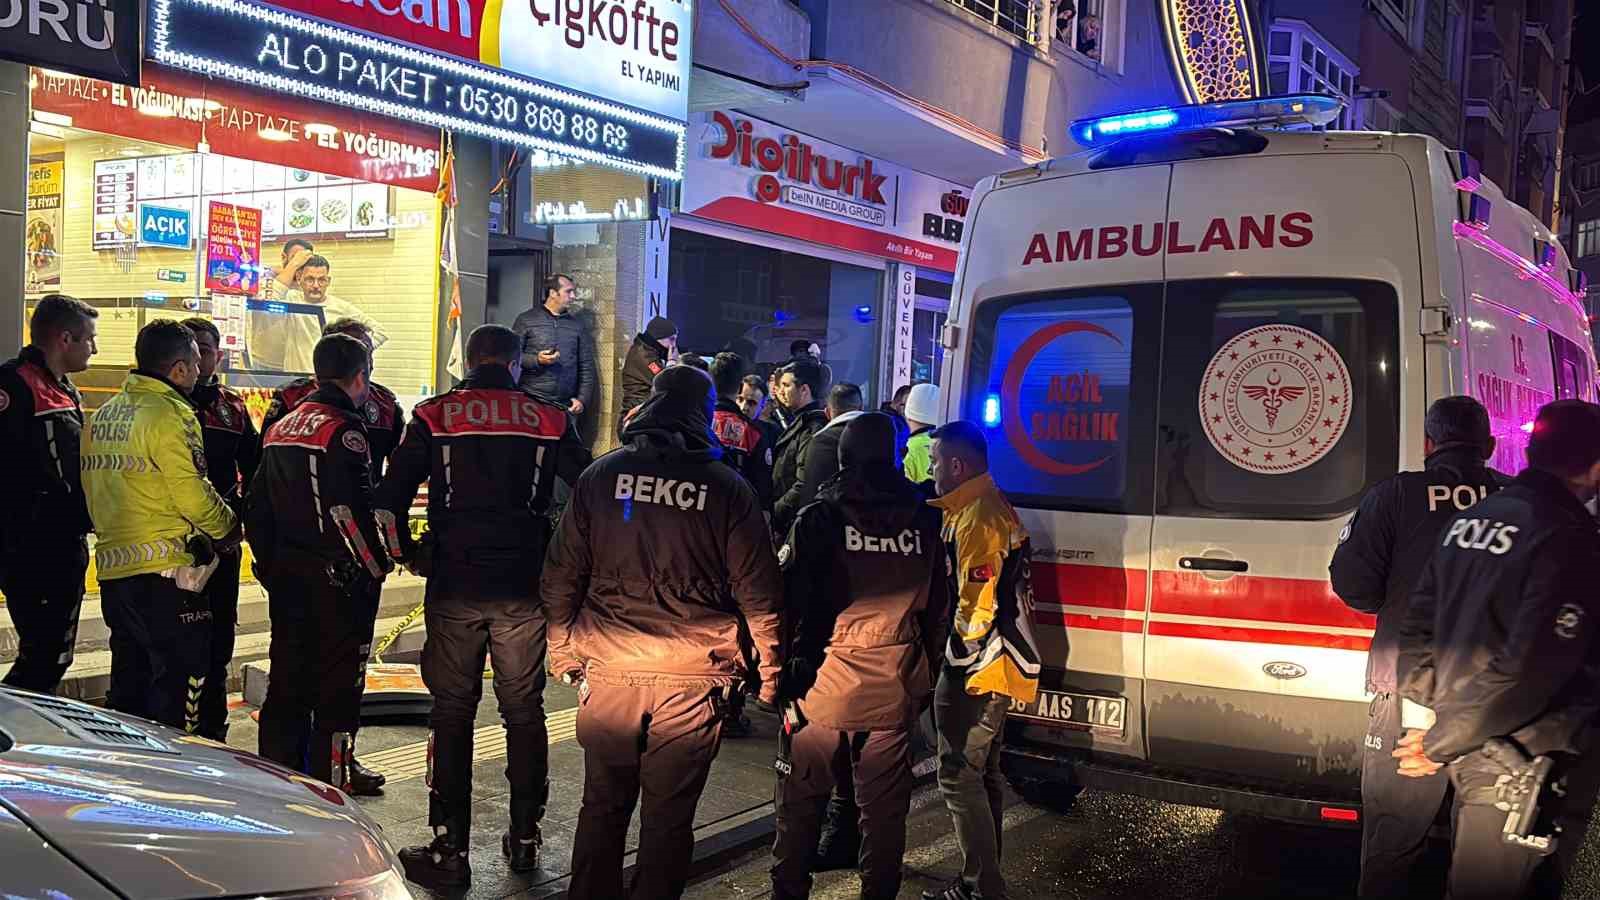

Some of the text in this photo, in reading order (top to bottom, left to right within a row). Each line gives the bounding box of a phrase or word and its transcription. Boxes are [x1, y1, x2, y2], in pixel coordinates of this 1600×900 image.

[0, 0, 114, 49] RÜ
[258, 33, 326, 74] ALO
[338, 52, 437, 103] PAKET
[460, 84, 518, 122] 0530
[525, 101, 565, 135] 869
[571, 114, 598, 143] 88
[621, 60, 680, 91] EL YAPIMI
[40, 73, 98, 101] TAPTAZE
[111, 84, 128, 107] EL
[131, 85, 204, 121] YOĞURMASI
[219, 105, 300, 142] TAPTAZE
[317, 130, 339, 150] EL
[343, 131, 439, 169] YOĞURMASI
[816, 195, 848, 213] MEDIA
[849, 205, 882, 222] GROUP
[211, 244, 223, 255] 70
[1022, 212, 1313, 265] AMBULANS
[1038, 693, 1072, 719] AAS
[1086, 699, 1120, 726] 112
